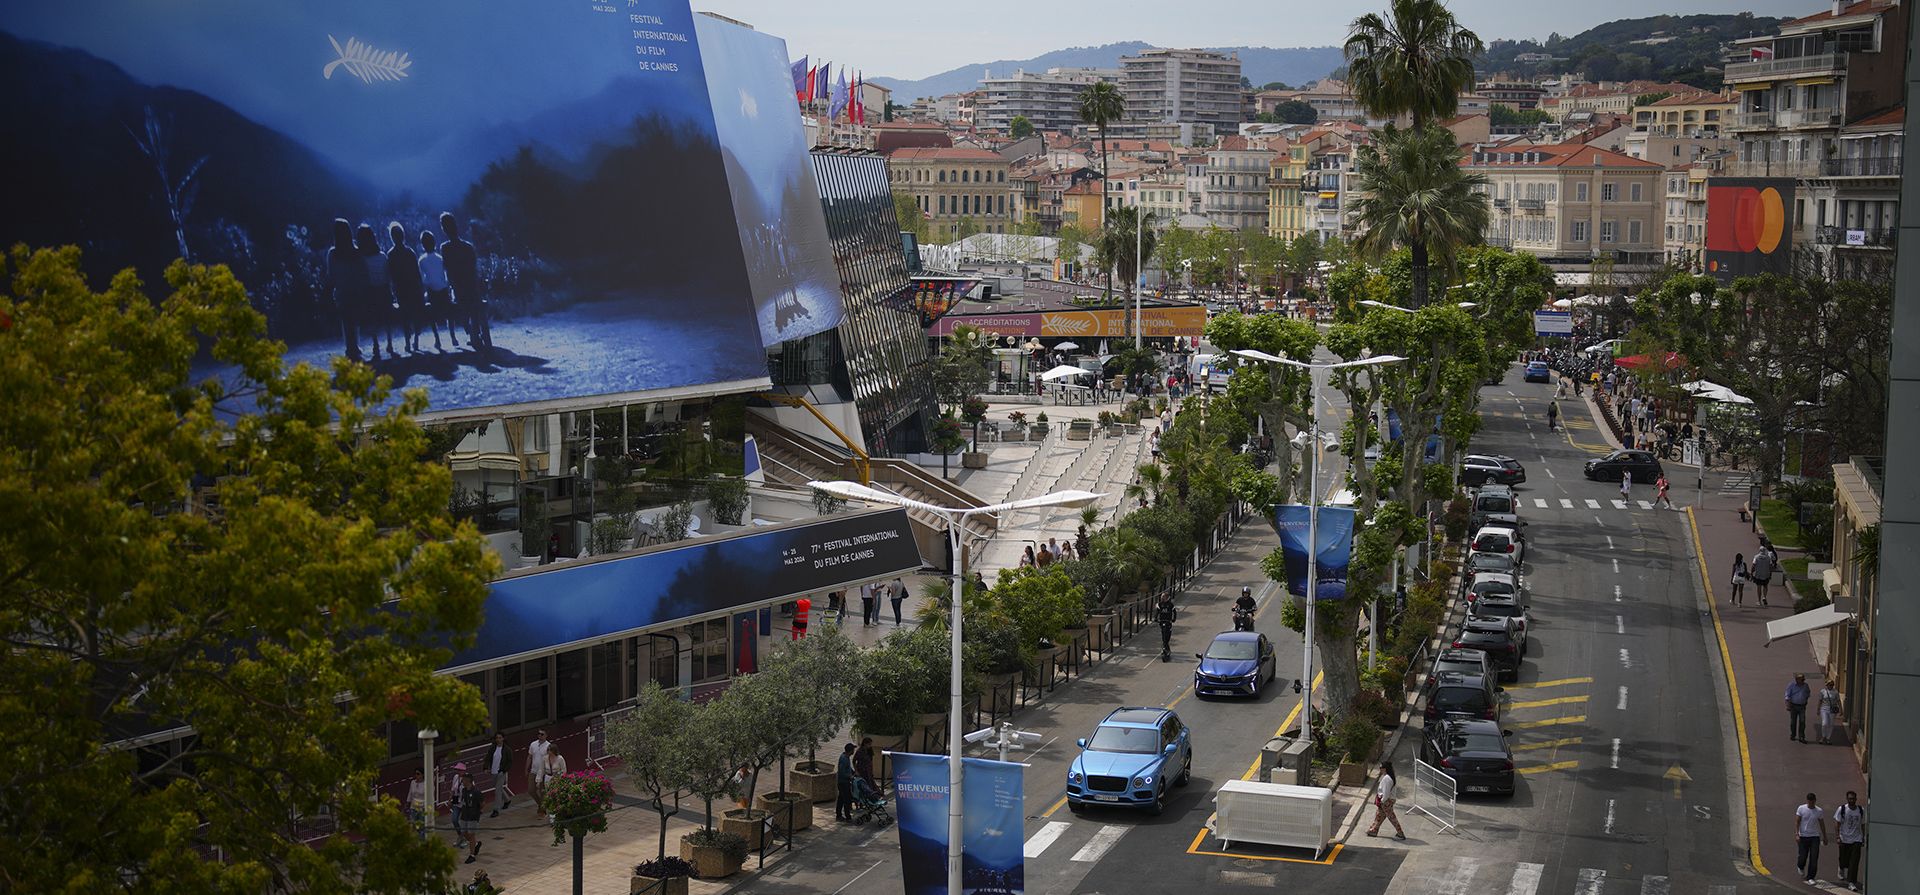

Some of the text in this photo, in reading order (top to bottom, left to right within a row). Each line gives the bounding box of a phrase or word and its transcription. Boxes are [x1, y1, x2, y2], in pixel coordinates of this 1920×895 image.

[630, 14, 663, 25] FESTIVAL
[633, 30, 688, 42] INTERNATIONAL
[636, 45, 666, 56] DU FILM
[639, 61, 679, 72] DE CANNES
[1127, 311, 1168, 319] ETIVAL
[968, 317, 1031, 326] ACCRÉDITATIONS
[1108, 319, 1176, 327] INTENATIONAL
[1108, 327, 1121, 335] DU
[1151, 327, 1163, 335] DE
[1168, 327, 1204, 335] CANNES
[824, 538, 853, 551] FESTIVAL
[853, 529, 899, 546] INTERNATIONAL
[814, 549, 875, 569] DU FILM DE CANNES
[898, 783, 949, 794] BIENVENUE
[898, 791, 945, 800] WELCOME
